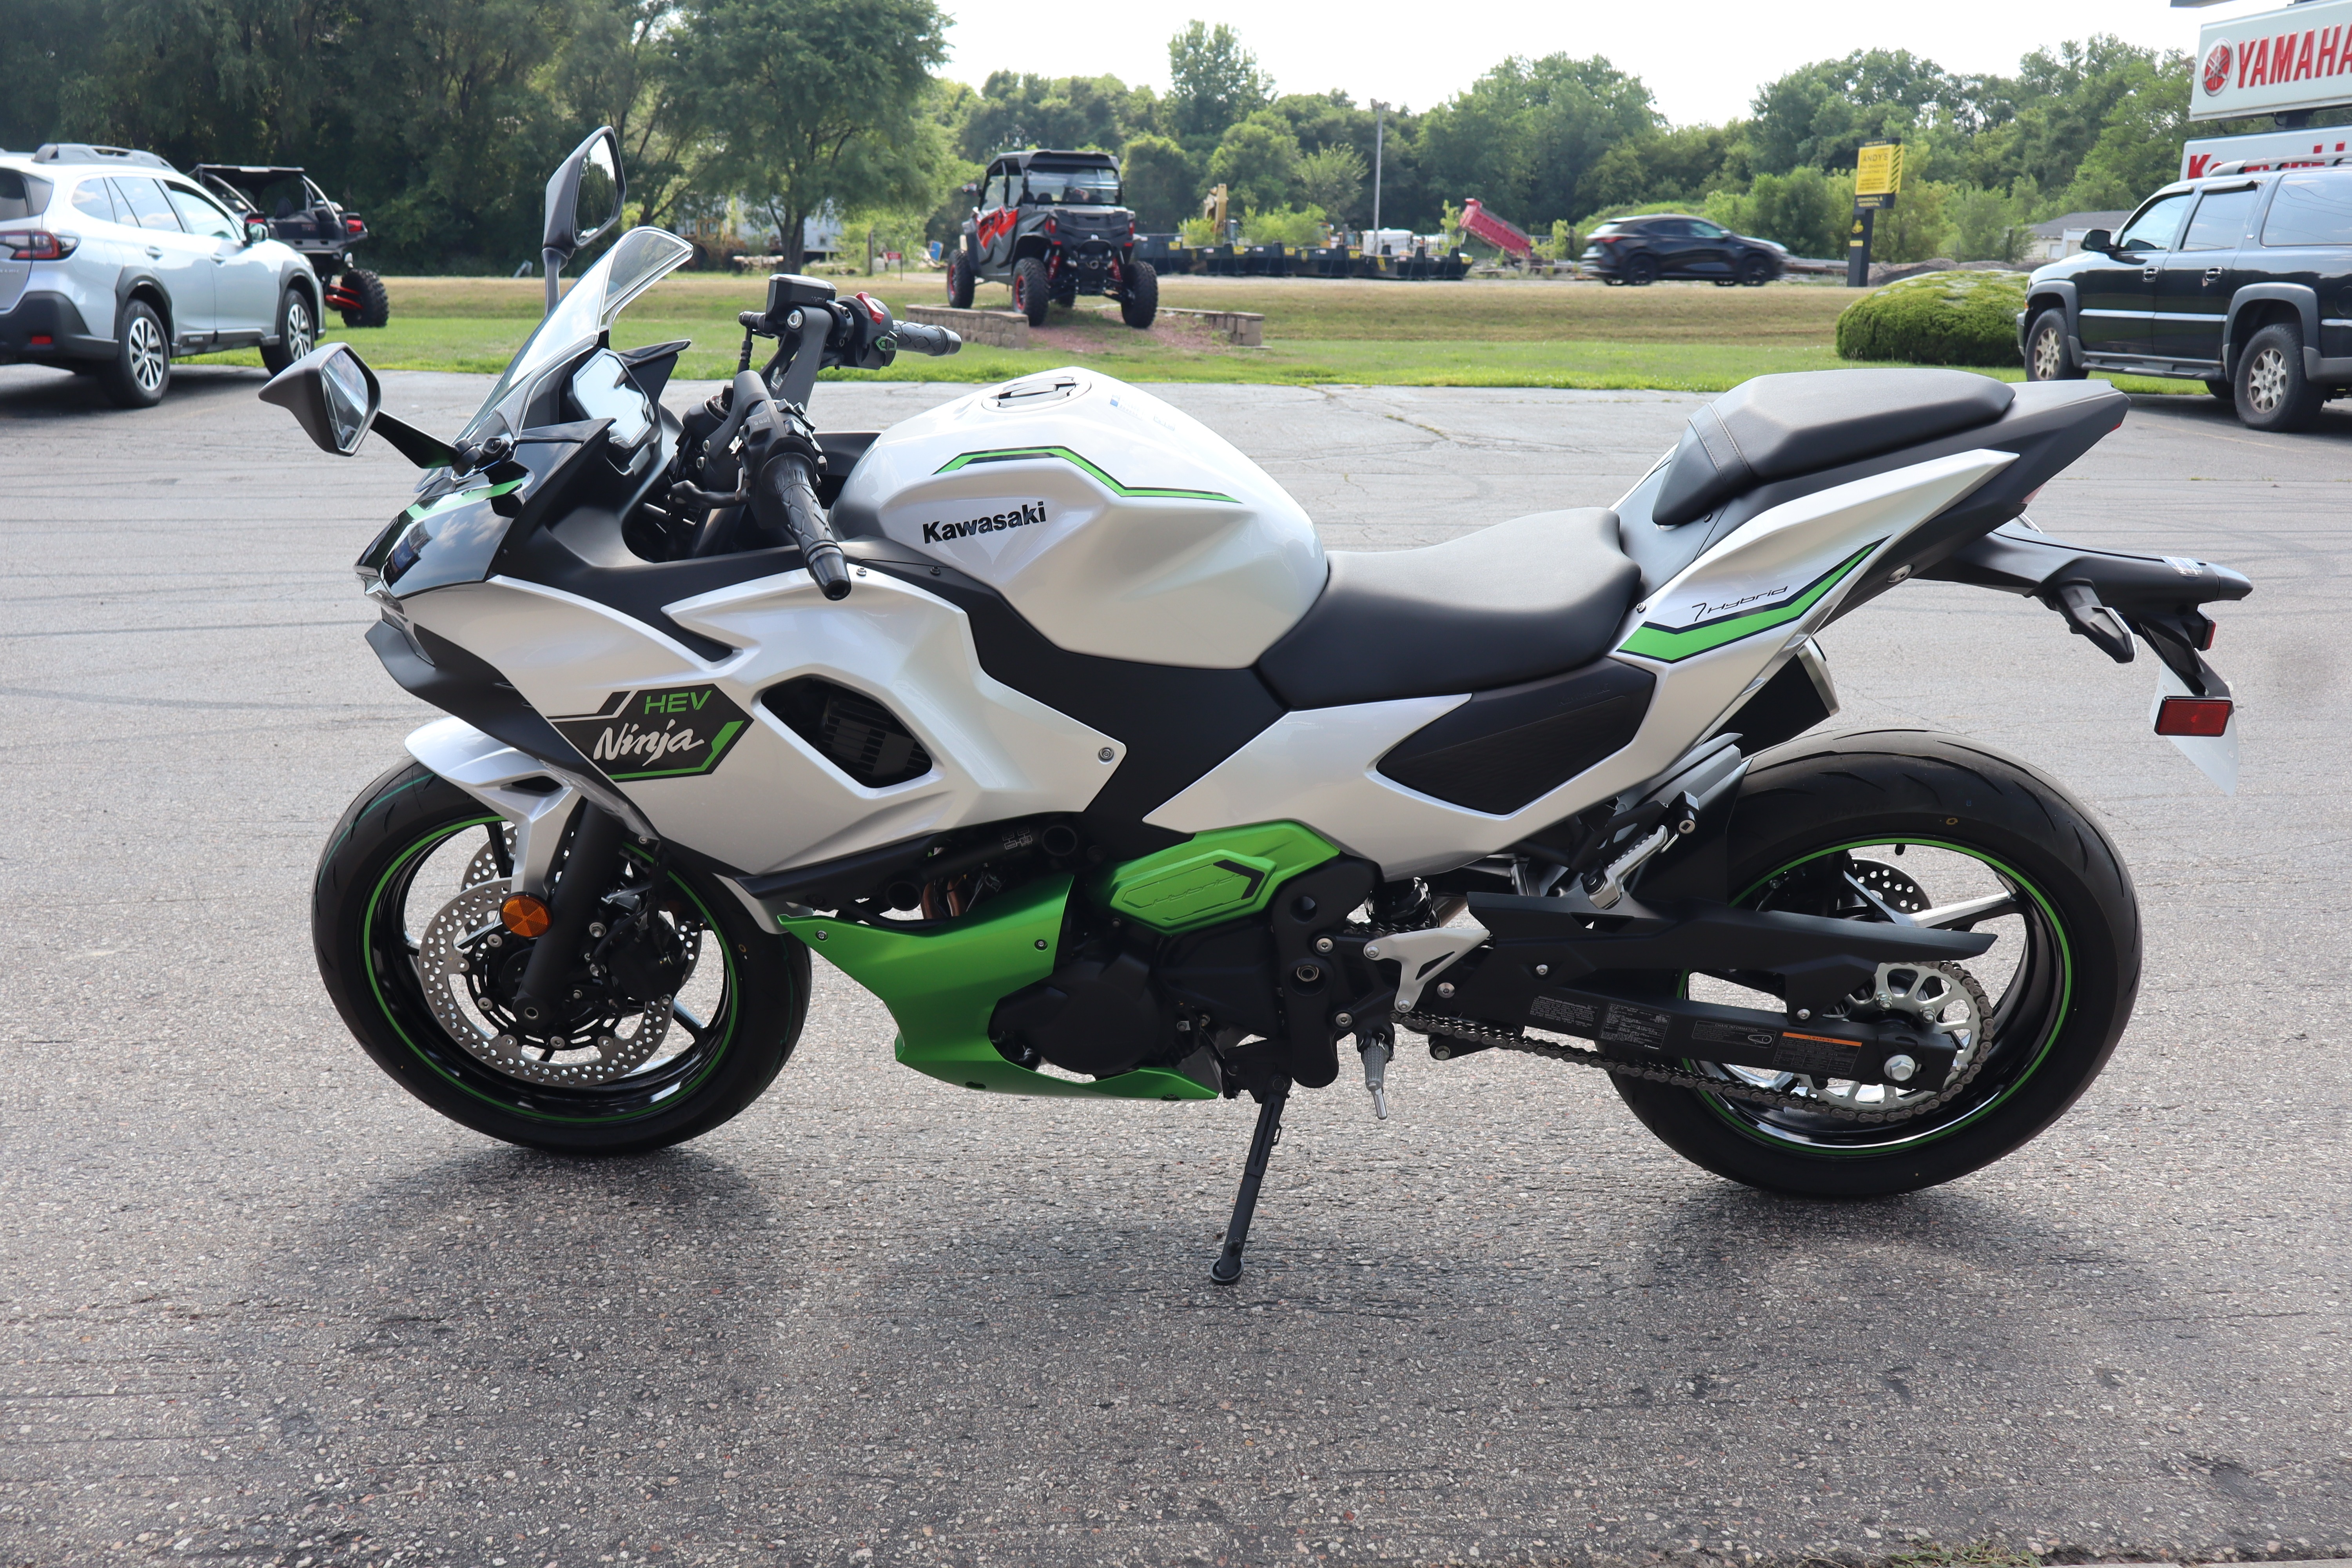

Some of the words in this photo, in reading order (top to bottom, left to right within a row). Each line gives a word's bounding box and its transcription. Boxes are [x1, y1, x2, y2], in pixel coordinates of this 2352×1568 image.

[2238, 23, 2352, 89] YAMAHA
[922, 501, 1046, 544] Kawasaki
[1707, 586, 1788, 614] Hybrid
[644, 690, 712, 714] HEV
[593, 719, 705, 767] Ninja
